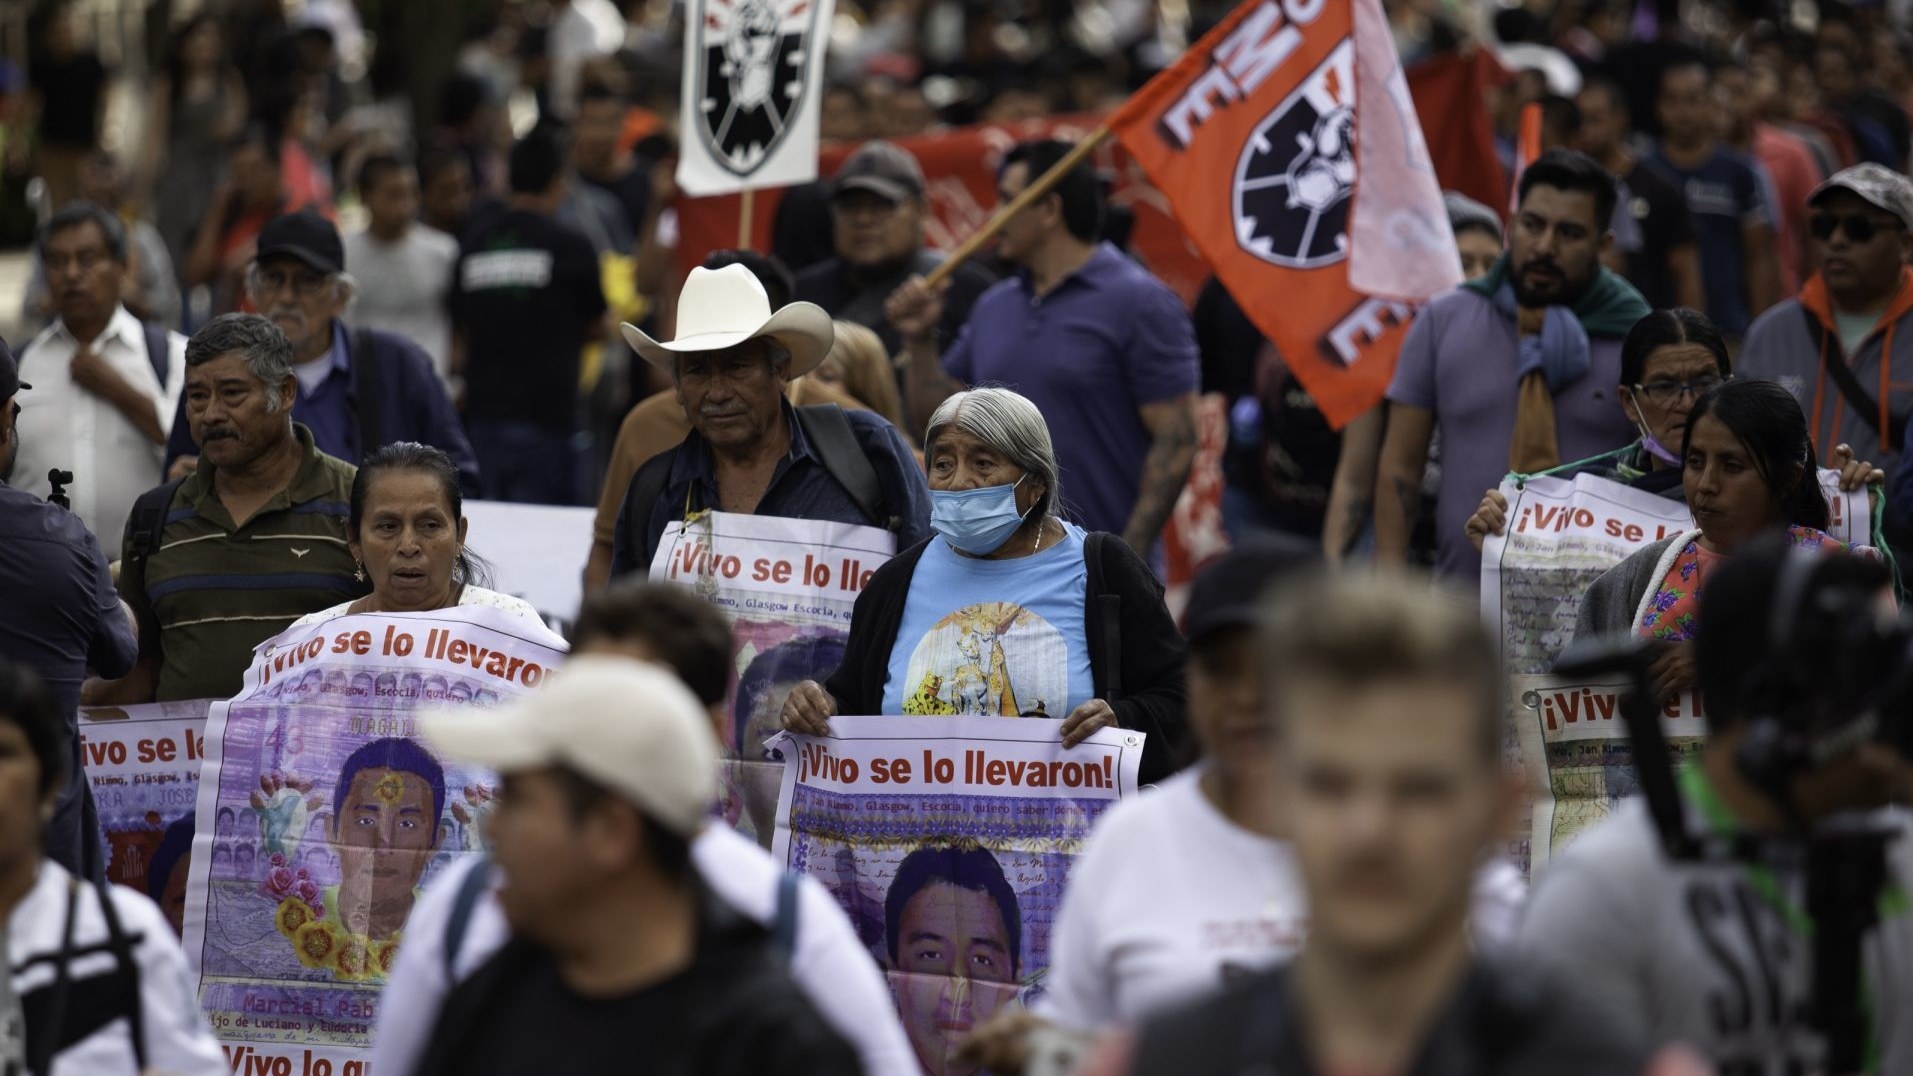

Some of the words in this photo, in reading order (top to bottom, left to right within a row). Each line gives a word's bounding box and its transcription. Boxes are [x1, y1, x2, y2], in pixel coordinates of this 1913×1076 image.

[1604, 517, 1644, 542] se
[671, 540, 741, 580] ¡Vivo
[752, 558, 792, 584] se
[803, 554, 831, 588] lo
[745, 600, 788, 612] Glasgow
[794, 602, 837, 619] Escocia,
[331, 630, 372, 655] se
[382, 625, 414, 657] lo
[1544, 687, 1622, 731] ¡Viv
[137, 737, 177, 763] se
[800, 742, 859, 784] ¡Vivo
[870, 757, 912, 784] se
[923, 750, 954, 784] lo
[965, 750, 1113, 789] llevaron!
[865, 801, 914, 813] Glasgow,
[973, 803, 1009, 813] quiero
[1016, 805, 1048, 815] saber
[242, 991, 325, 1016] Marcial
[336, 998, 374, 1018] Pab
[208, 1013, 230, 1028] ijo
[235, 1016, 249, 1027] de
[255, 1018, 301, 1031] Luciano
[307, 1023, 315, 1033] y
